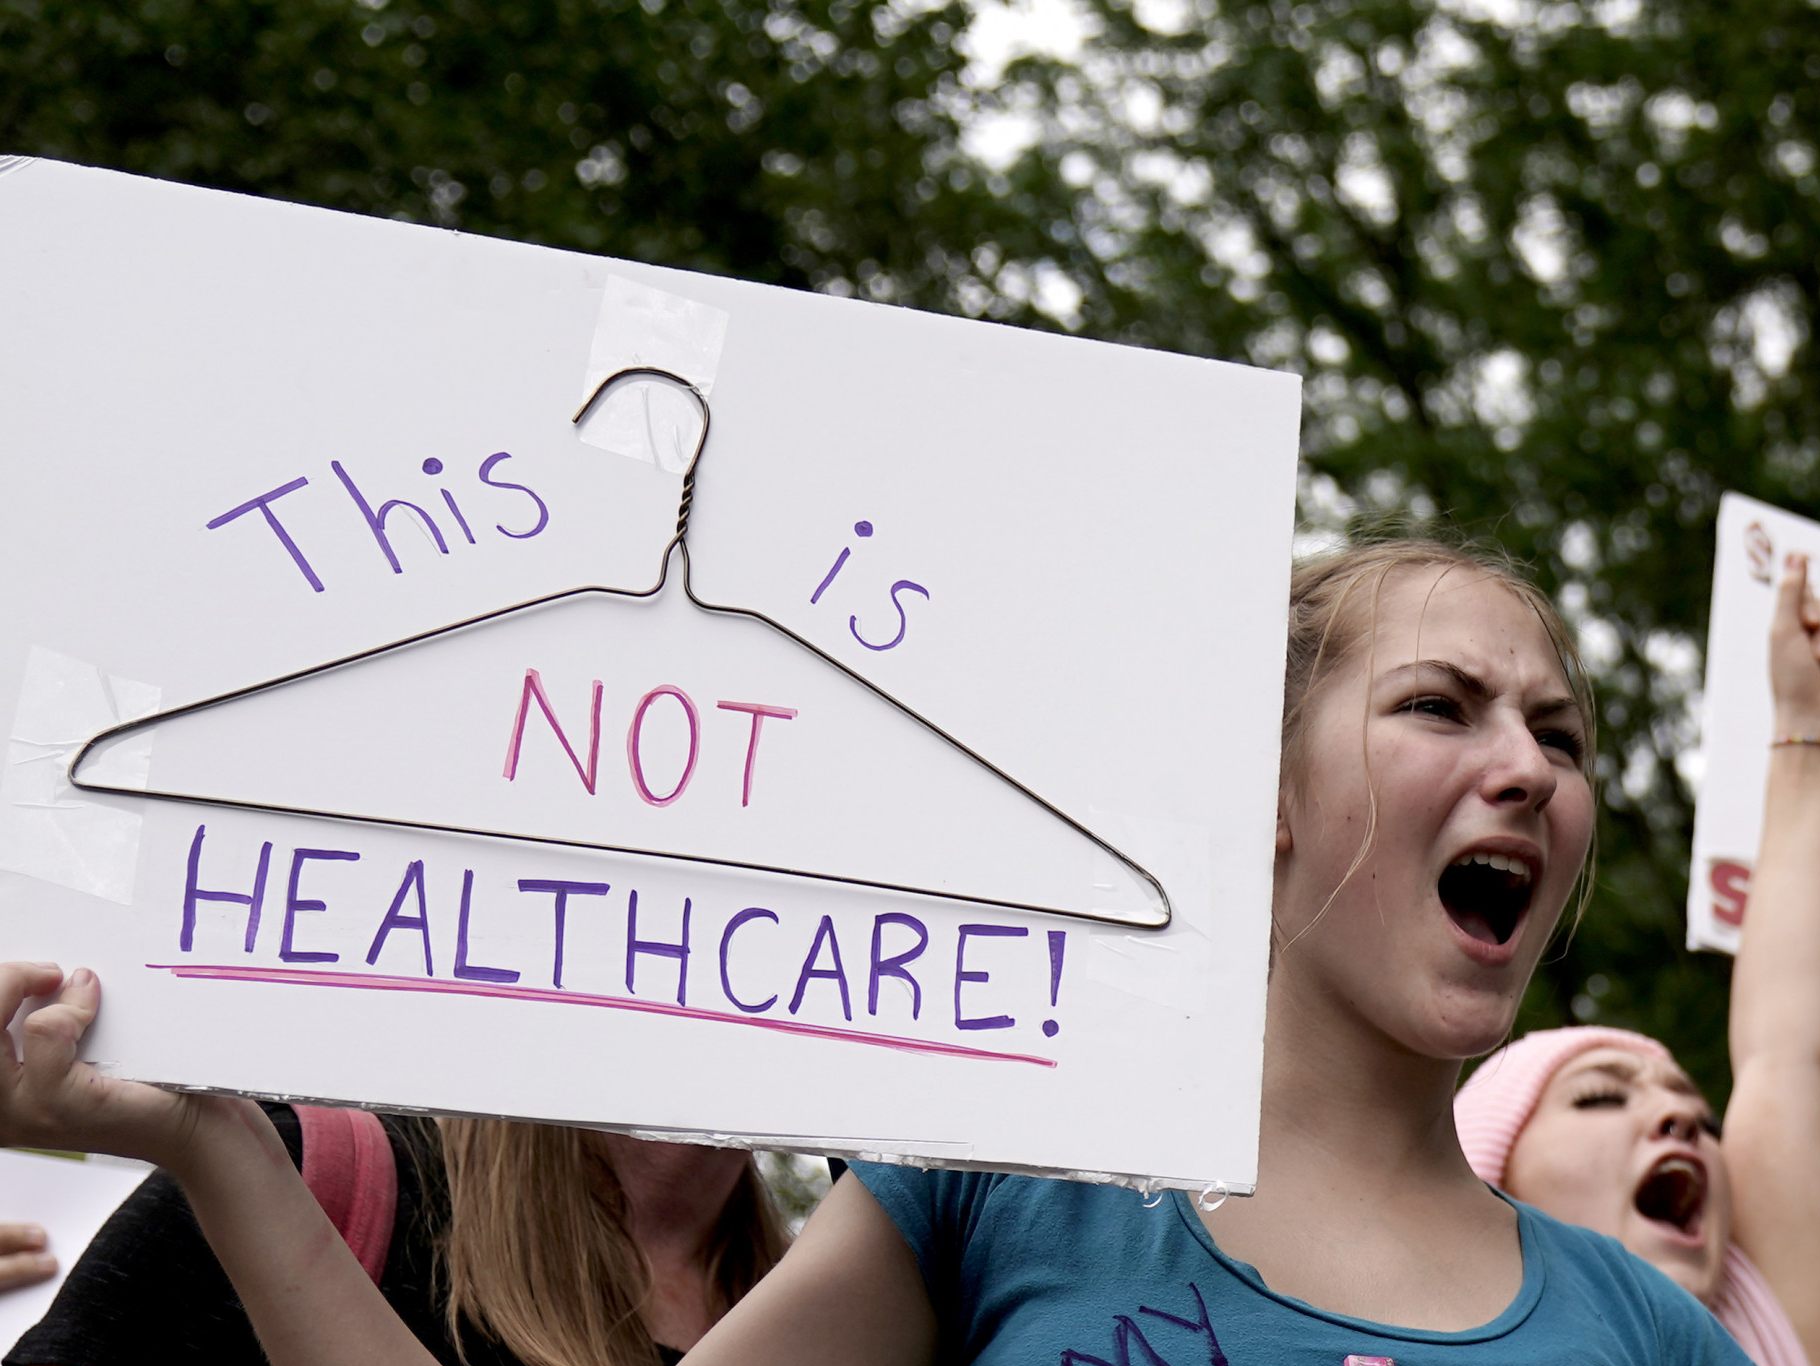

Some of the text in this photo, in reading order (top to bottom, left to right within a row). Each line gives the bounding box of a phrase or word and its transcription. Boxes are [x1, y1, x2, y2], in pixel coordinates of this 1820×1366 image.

[205, 450, 931, 652] This is
[504, 666, 800, 807] NOT
[180, 822, 1068, 1038] HEALTHCARE!
